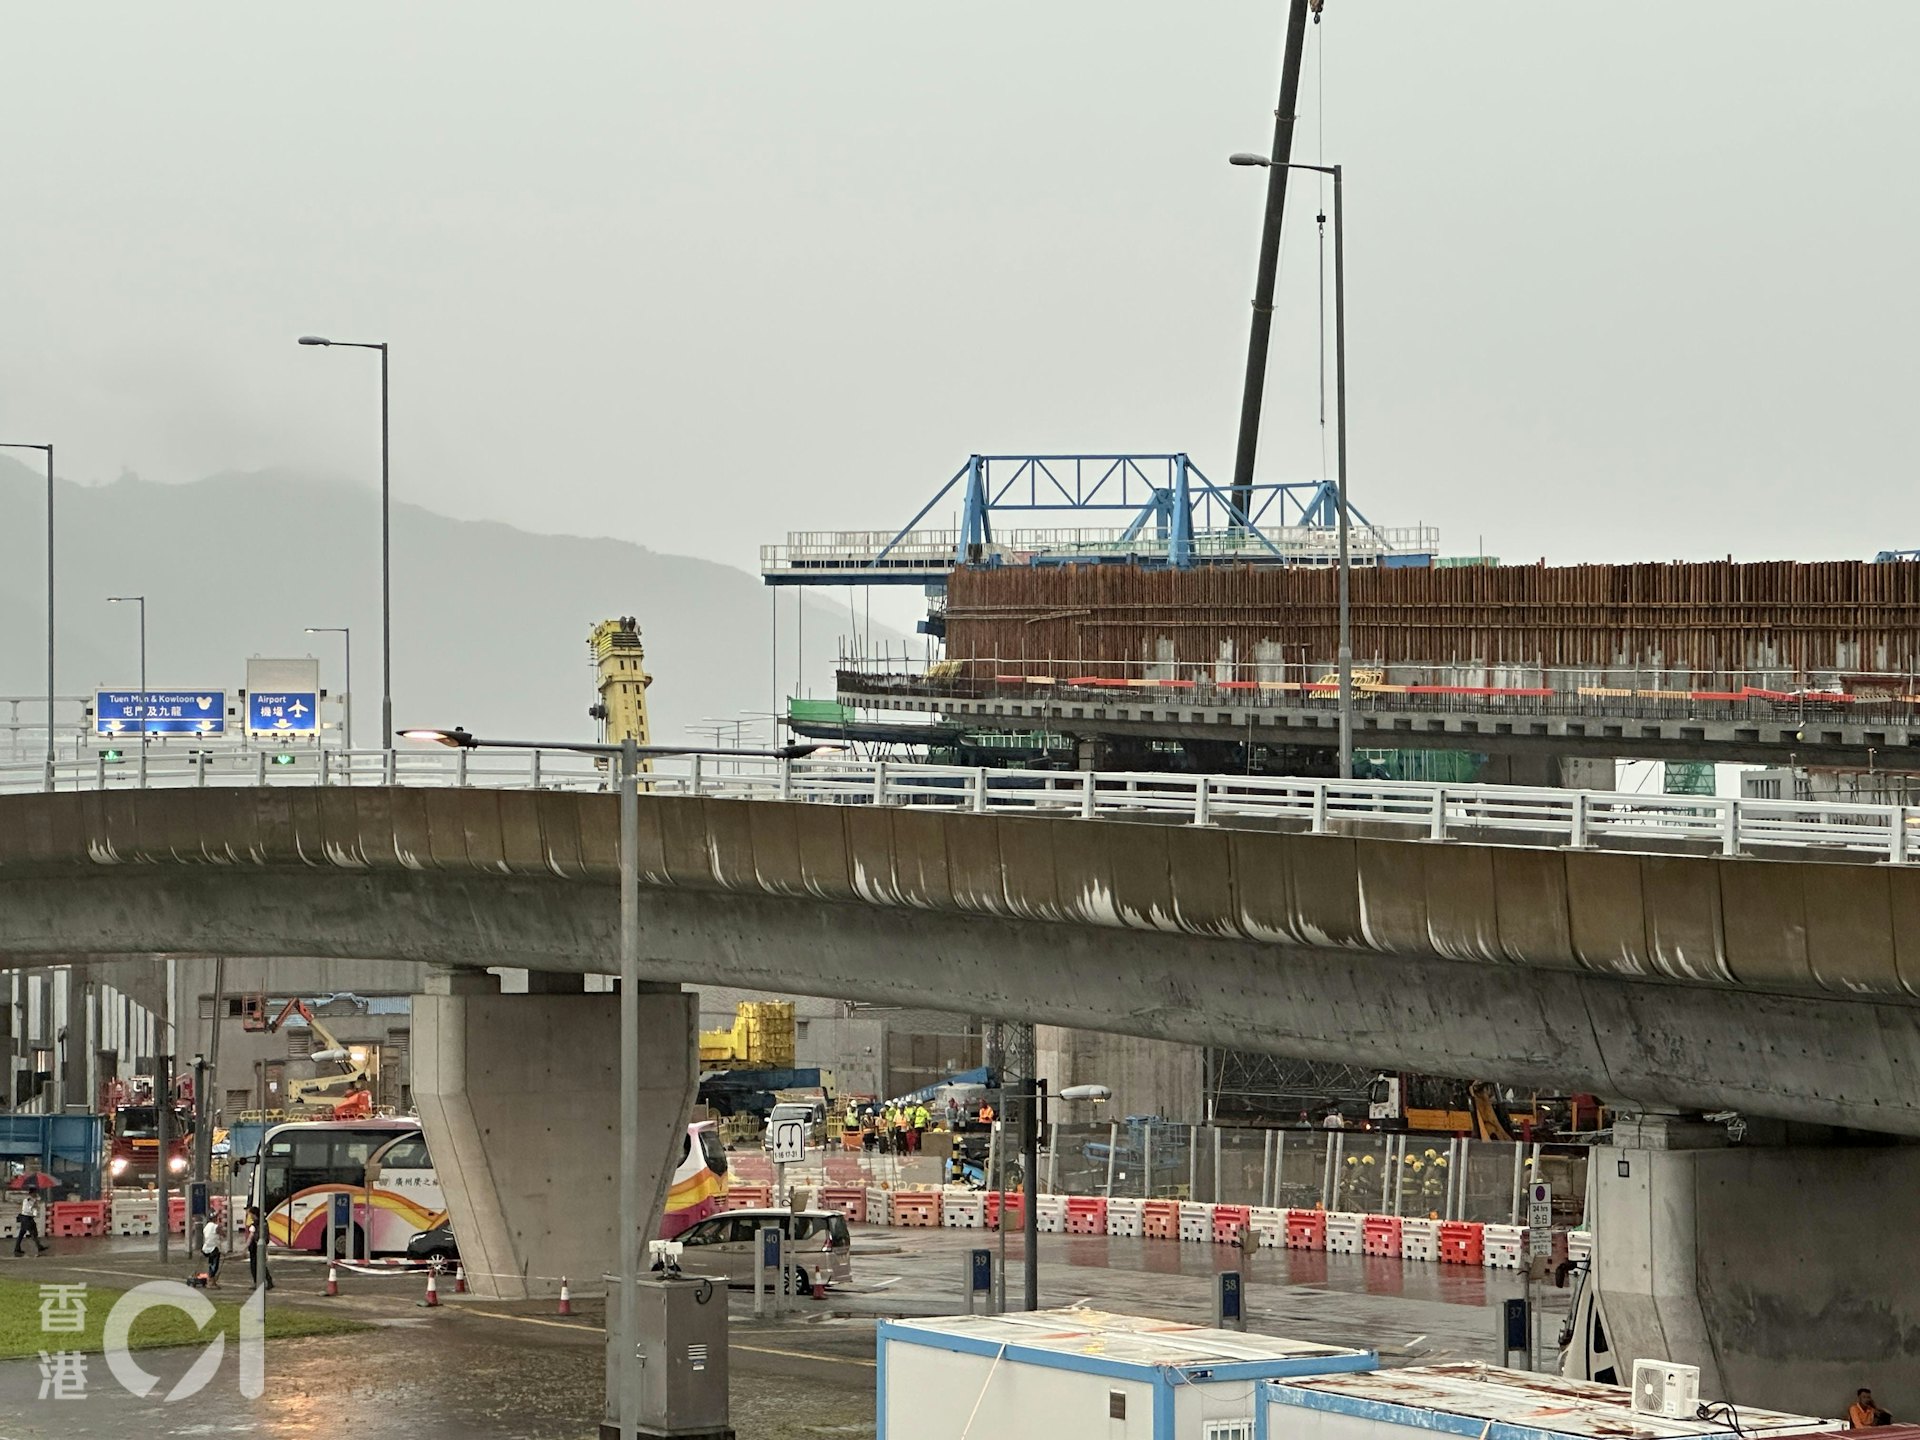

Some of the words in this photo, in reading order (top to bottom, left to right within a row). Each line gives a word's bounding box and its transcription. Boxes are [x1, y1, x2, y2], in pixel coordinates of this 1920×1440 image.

[109, 695, 129, 703] Tuen
[131, 695, 149, 703] Mun
[151, 695, 157, 703] &
[159, 695, 195, 703] Kowloon
[258, 695, 287, 704] Airport
[123, 706, 182, 717] 屯門及九龍
[261, 706, 283, 717] 機場
[337, 1198, 348, 1206] 42
[1534, 1214, 1547, 1224] 全日
[766, 1234, 777, 1244] 40
[975, 1256, 987, 1266] 39
[1225, 1280, 1237, 1291] 38
[1511, 1307, 1522, 1319] 37
